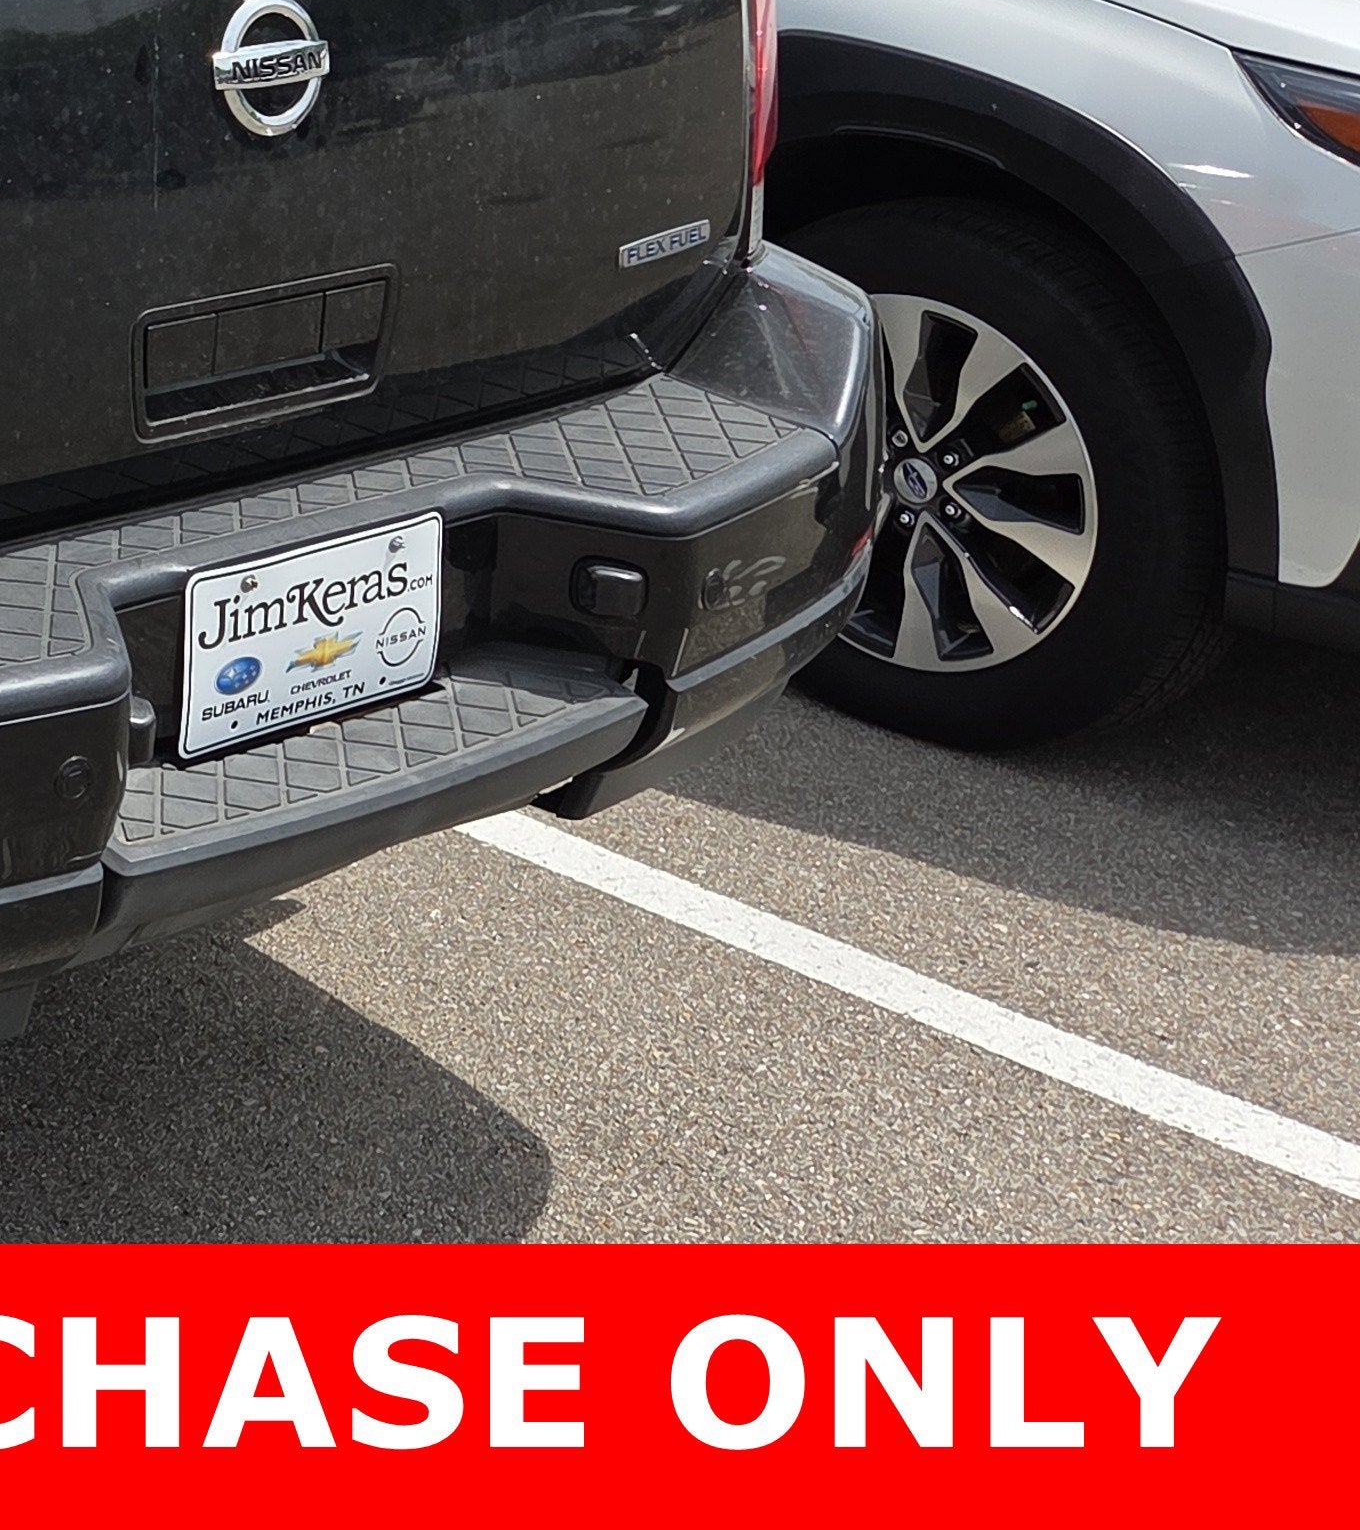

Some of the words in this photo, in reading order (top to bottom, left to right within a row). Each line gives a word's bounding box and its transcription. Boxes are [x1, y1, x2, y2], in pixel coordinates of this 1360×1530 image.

[231, 51, 323, 81] NISSAN
[626, 239, 666, 264] FLEX
[669, 227, 707, 251] FUEL
[375, 626, 427, 650] NISSAN
[290, 669, 353, 696] CHEVROLET
[201, 690, 270, 721] SUBARU
[255, 690, 336, 725] MEMPHIS,
[342, 681, 366, 700] TN
